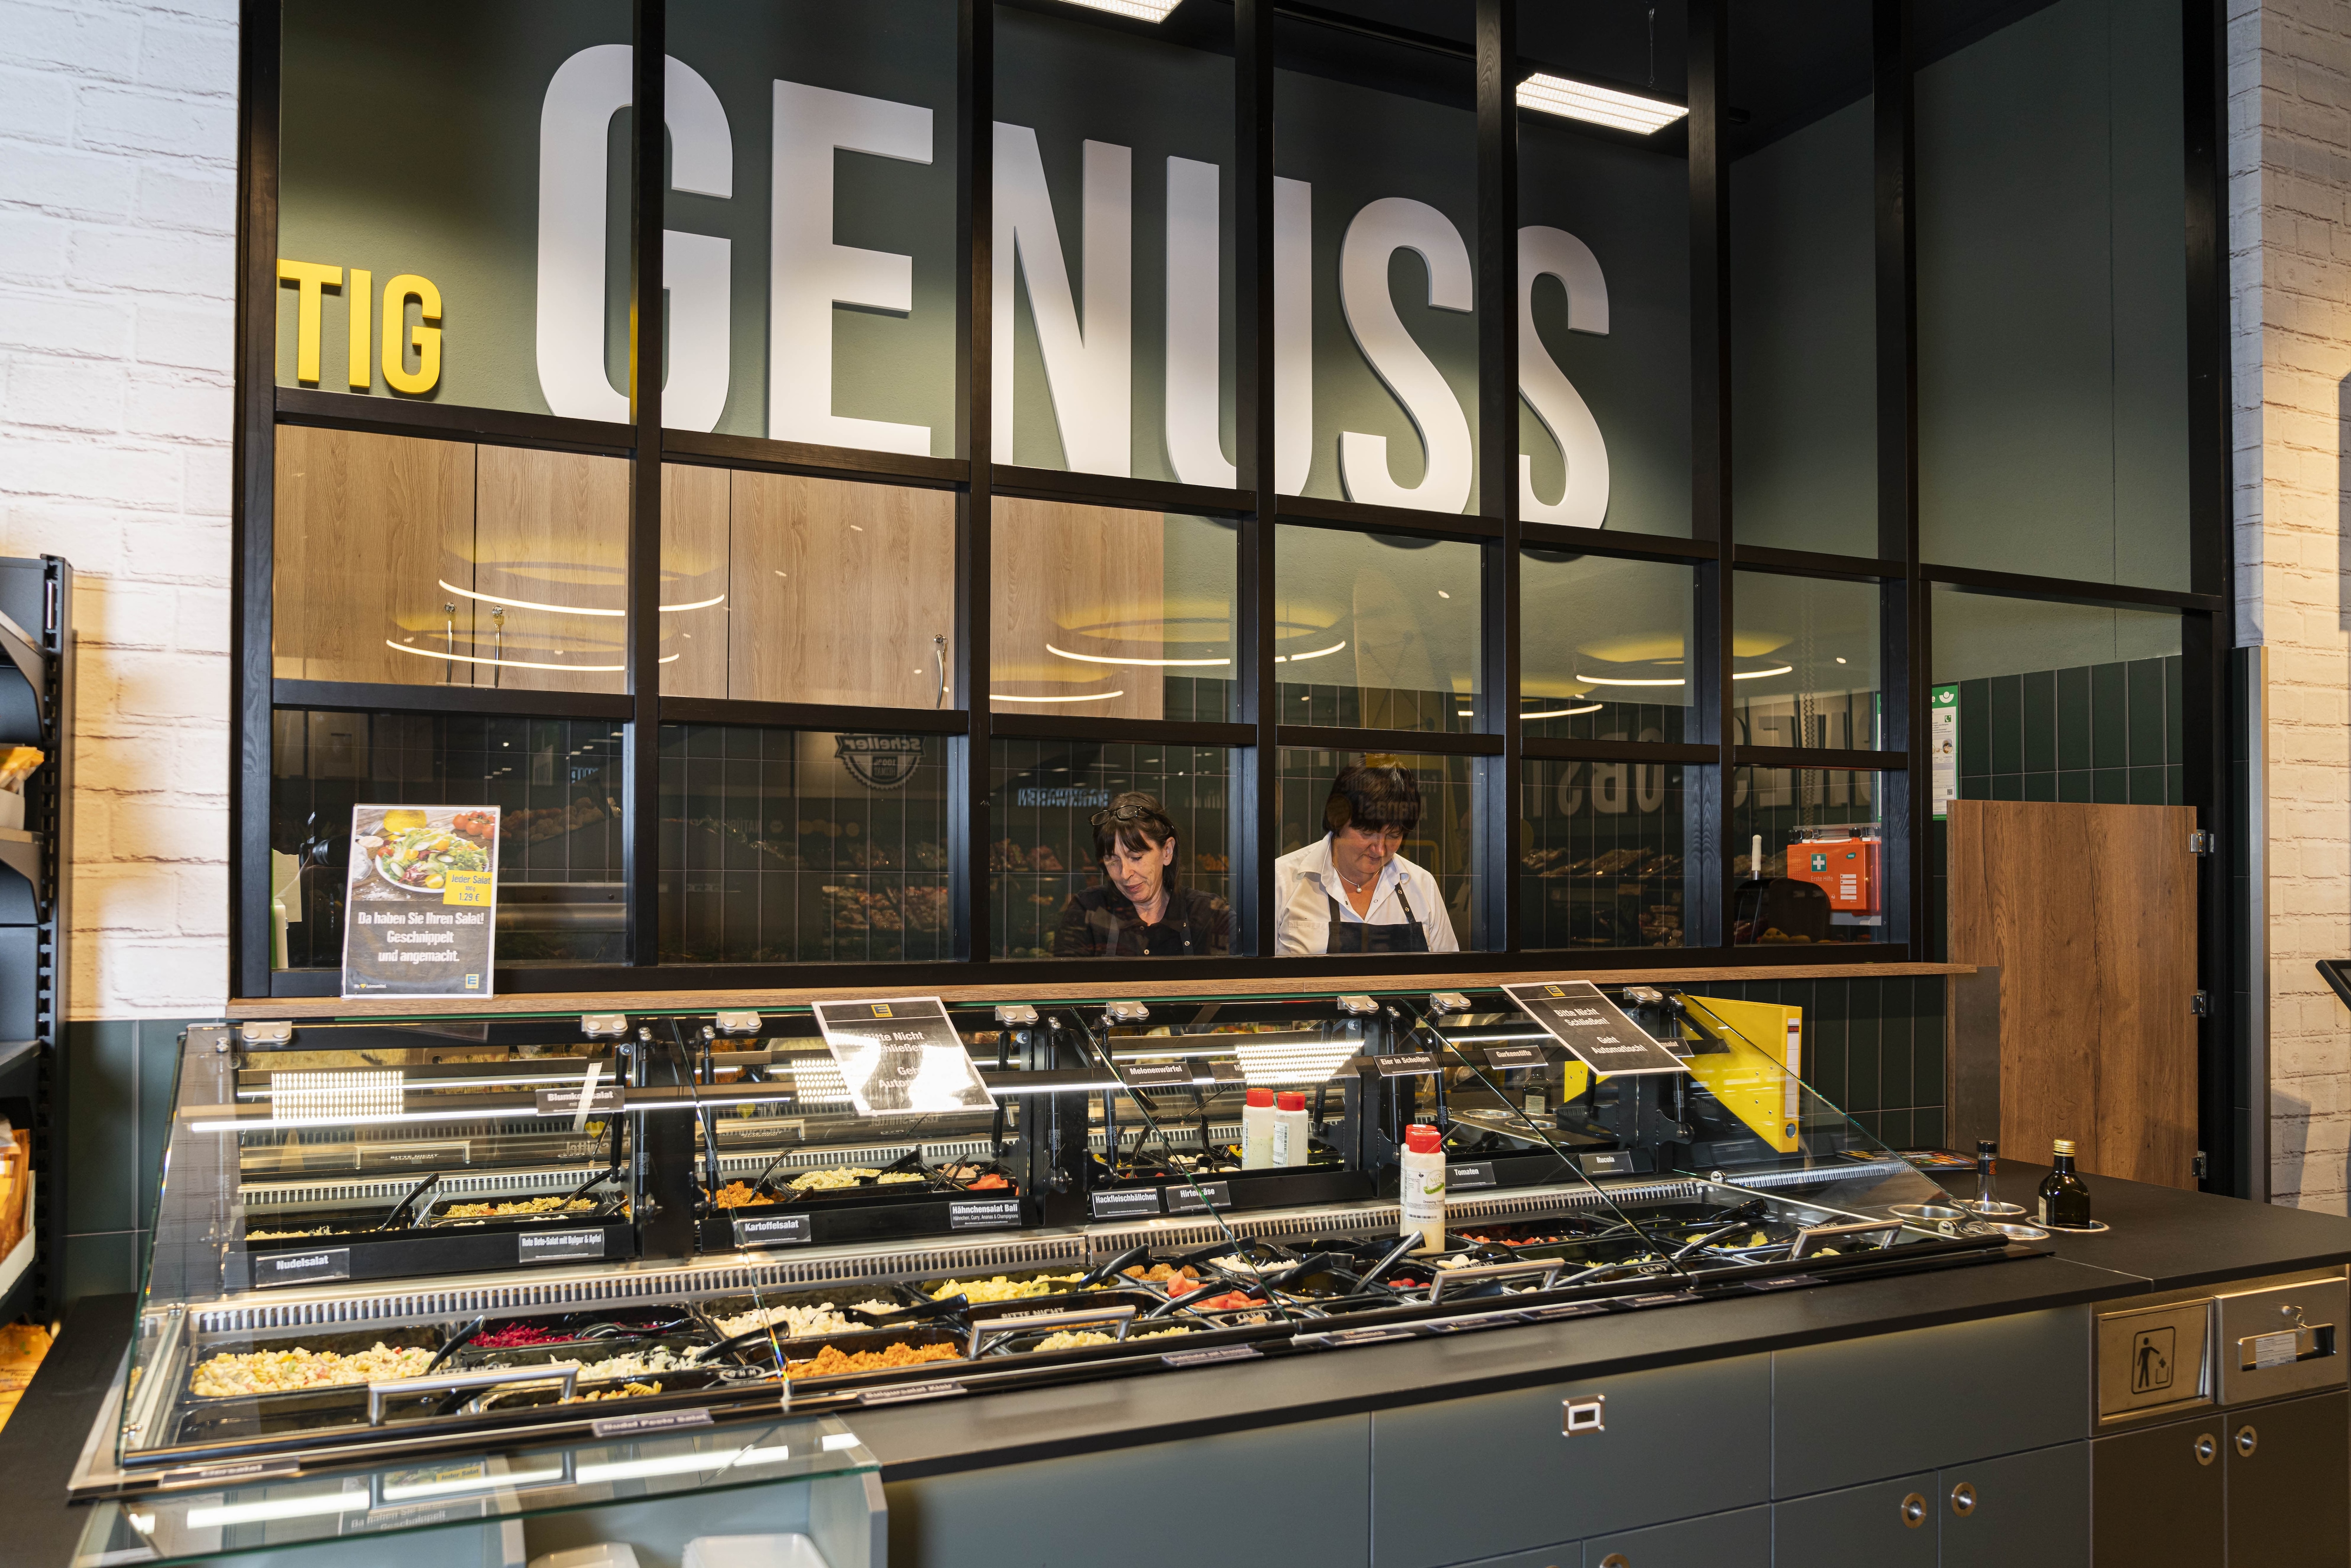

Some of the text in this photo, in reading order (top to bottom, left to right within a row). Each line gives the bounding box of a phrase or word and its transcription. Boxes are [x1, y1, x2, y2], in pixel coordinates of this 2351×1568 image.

[536, 44, 1609, 530] GENUSS
[276, 258, 442, 395] TIG
[451, 874, 490, 884] Jeder Salat
[358, 911, 485, 925] Da haben Sie Ihren Salat!
[387, 930, 455, 946] Geschnippelt
[378, 949, 460, 965] und angemacht.
[1564, 1017, 1610, 1026] Schließen!
[892, 1032, 925, 1040] Nicht
[1496, 1049, 1532, 1058] Gurkenstifte
[1590, 1044, 1648, 1054] Automatisch!
[1129, 1065, 1183, 1075] Melonenwürfel
[547, 1090, 614, 1102] Blumkosalat
[1180, 1187, 1215, 1198] Hirteäse
[1095, 1193, 1157, 1204] Hackfleischbällchen
[952, 1204, 1018, 1214] Hähnchensalat Bali
[745, 1220, 799, 1232] Kartoffelsalat
[522, 1234, 601, 1247] Rote Bete-Salat mit Bulgur & Apfel
[276, 1255, 329, 1270] Nudelsalat
[1032, 1307, 1065, 1316] NICHT
